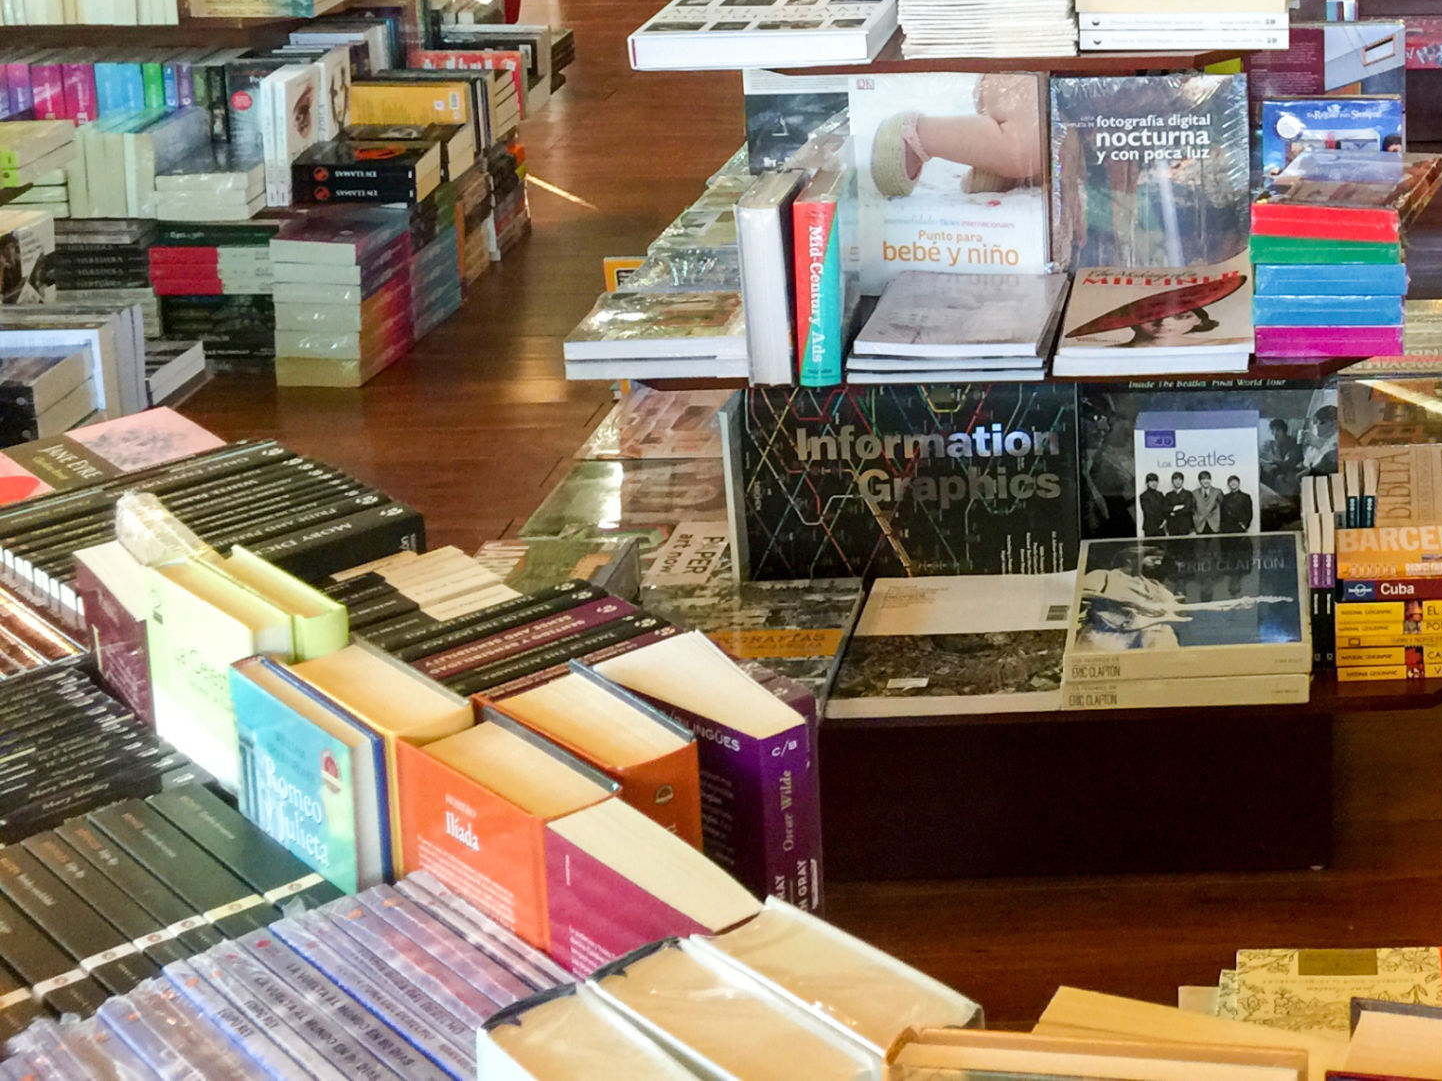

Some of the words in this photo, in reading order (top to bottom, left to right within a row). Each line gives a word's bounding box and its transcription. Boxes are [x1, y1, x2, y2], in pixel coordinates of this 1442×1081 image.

[1096, 114, 1164, 130] fotografía
[1168, 113, 1211, 130] digital
[1096, 129, 1210, 147] nocturna
[1096, 151, 1107, 164] y
[1110, 150, 1141, 161] con
[1144, 149, 1182, 164] poca
[1187, 146, 1210, 159] luz
[919, 230, 951, 241] Punto
[956, 233, 983, 243] para
[883, 241, 941, 262] bebé
[947, 247, 961, 267] y
[968, 244, 1019, 266] niño
[808, 225, 825, 328] Mid-Century
[812, 330, 826, 363] Ads
[1176, 380, 1206, 388] Beatles
[1237, 379, 1263, 387] World
[796, 422, 1060, 460] Information
[1175, 450, 1236, 467] Beatles
[858, 467, 1061, 509] Graphics
[1218, 557, 1285, 571] CLAPTON
[1380, 583, 1415, 596] Cuba
[1427, 606, 1440, 616] EL
[1071, 666, 1090, 679] ERIC
[1090, 665, 1121, 678] CLAPTON
[1068, 695, 1087, 706] ERIC
[1087, 693, 1118, 706] CLAPTON
[264, 754, 323, 825] Romeo
[779, 769, 794, 809] Wilde
[277, 800, 330, 868] Julieta
[445, 811, 480, 852] Ilíada
[783, 812, 795, 852] Oscar
